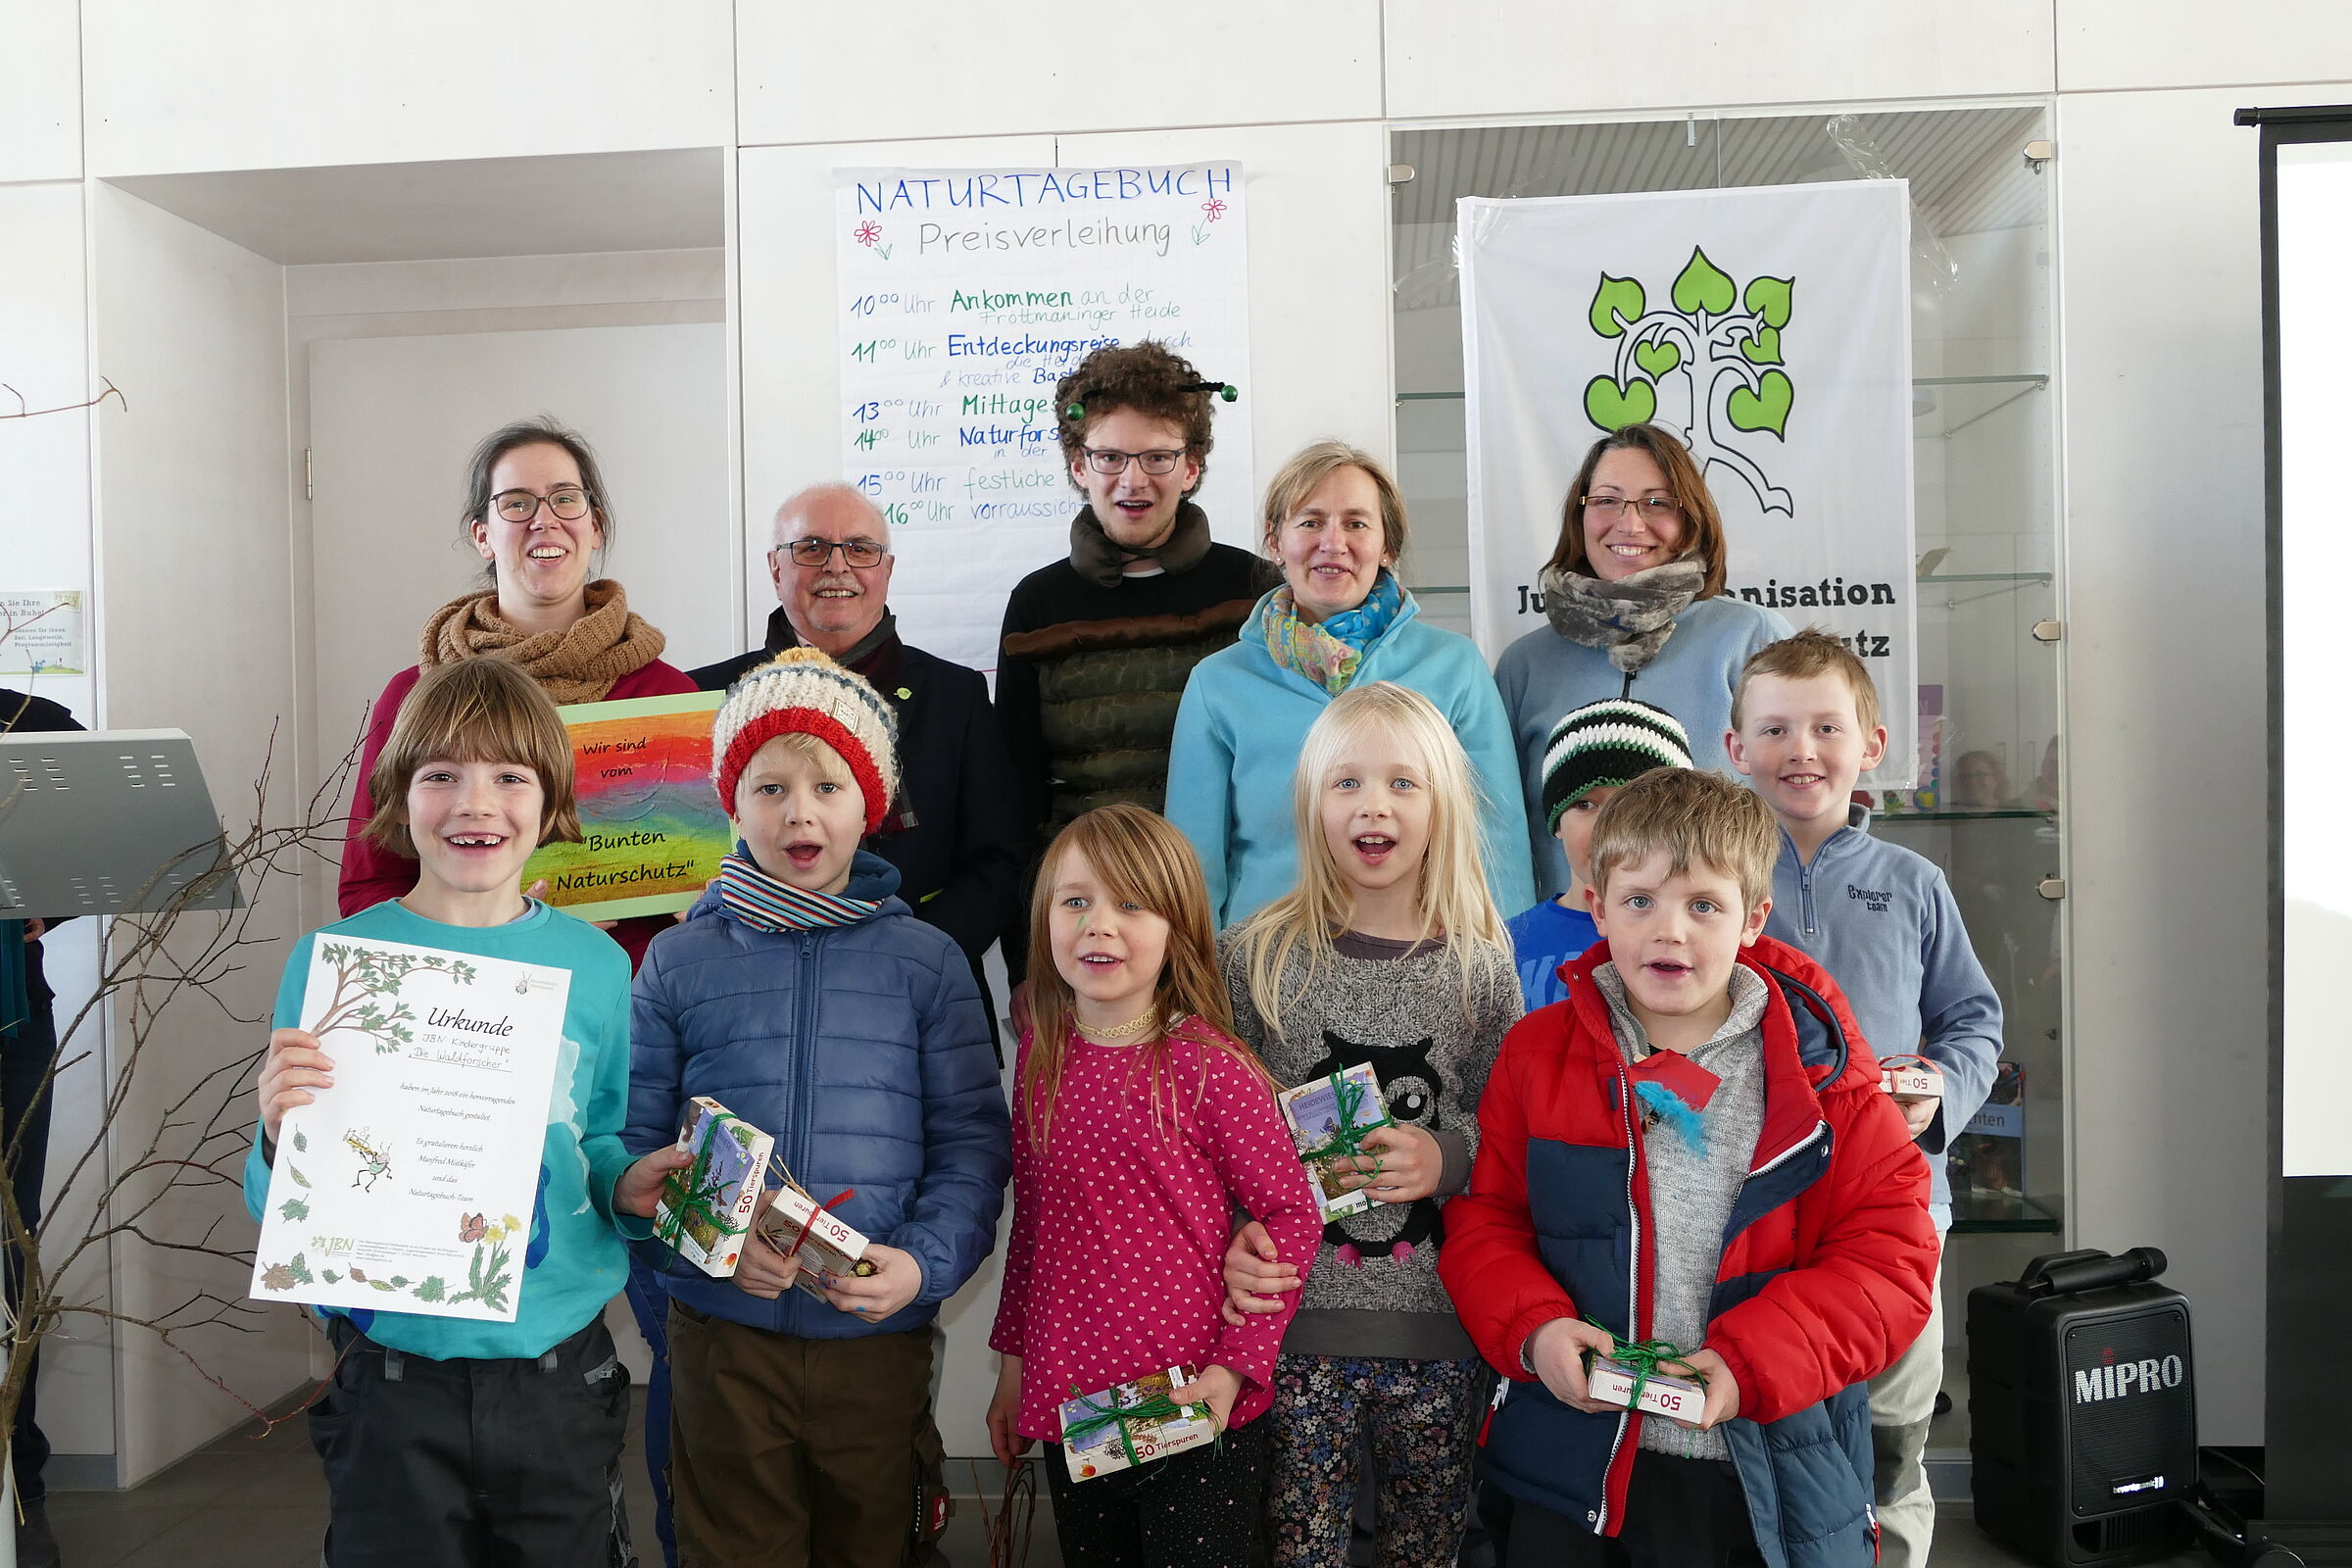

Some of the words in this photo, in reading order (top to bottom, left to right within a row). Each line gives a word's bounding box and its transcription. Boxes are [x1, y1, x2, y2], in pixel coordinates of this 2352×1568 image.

[858, 168, 1231, 214] NATURTAGEBUCH
[919, 217, 1170, 257] Preisverleihung
[904, 293, 936, 314] Uhr
[951, 288, 1073, 313] Ankommen
[1081, 290, 1110, 306] an
[1118, 282, 1154, 305] der
[1129, 301, 1181, 320] Heide
[905, 340, 937, 361] Uhr
[949, 333, 1120, 363] Entdeckungsreise
[1005, 355, 1032, 369] die
[958, 368, 1020, 386] kreative
[1033, 367, 1074, 384] Bast
[908, 400, 943, 418] Uhr
[961, 393, 1059, 424] Mittages
[908, 430, 940, 449] Uhr
[959, 423, 1061, 449] Naturfors
[994, 447, 1005, 459] in
[1021, 443, 1049, 458] der
[911, 471, 947, 494] Uhr
[963, 466, 1055, 501] festliche
[927, 500, 955, 521] Uhr
[1517, 585, 1546, 614] Ju
[582, 742, 611, 756] Wir
[615, 737, 647, 753] sind
[600, 767, 633, 778] vom
[556, 859, 695, 892] Naturschutz"
[1866, 901, 1888, 912] team
[427, 1006, 514, 1037] Urkunde
[422, 1034, 447, 1044] JBN
[451, 1038, 511, 1056] Kindergruppe
[1912, 1077, 1928, 1090] 50
[738, 1195, 754, 1214] 50
[747, 1152, 764, 1193] Tierspuren
[782, 1219, 802, 1233] 50
[829, 1224, 851, 1244] 50
[1660, 1394, 1682, 1411] 50
[1135, 1445, 1155, 1459] 50
[1155, 1433, 1199, 1450] Tierspuren
